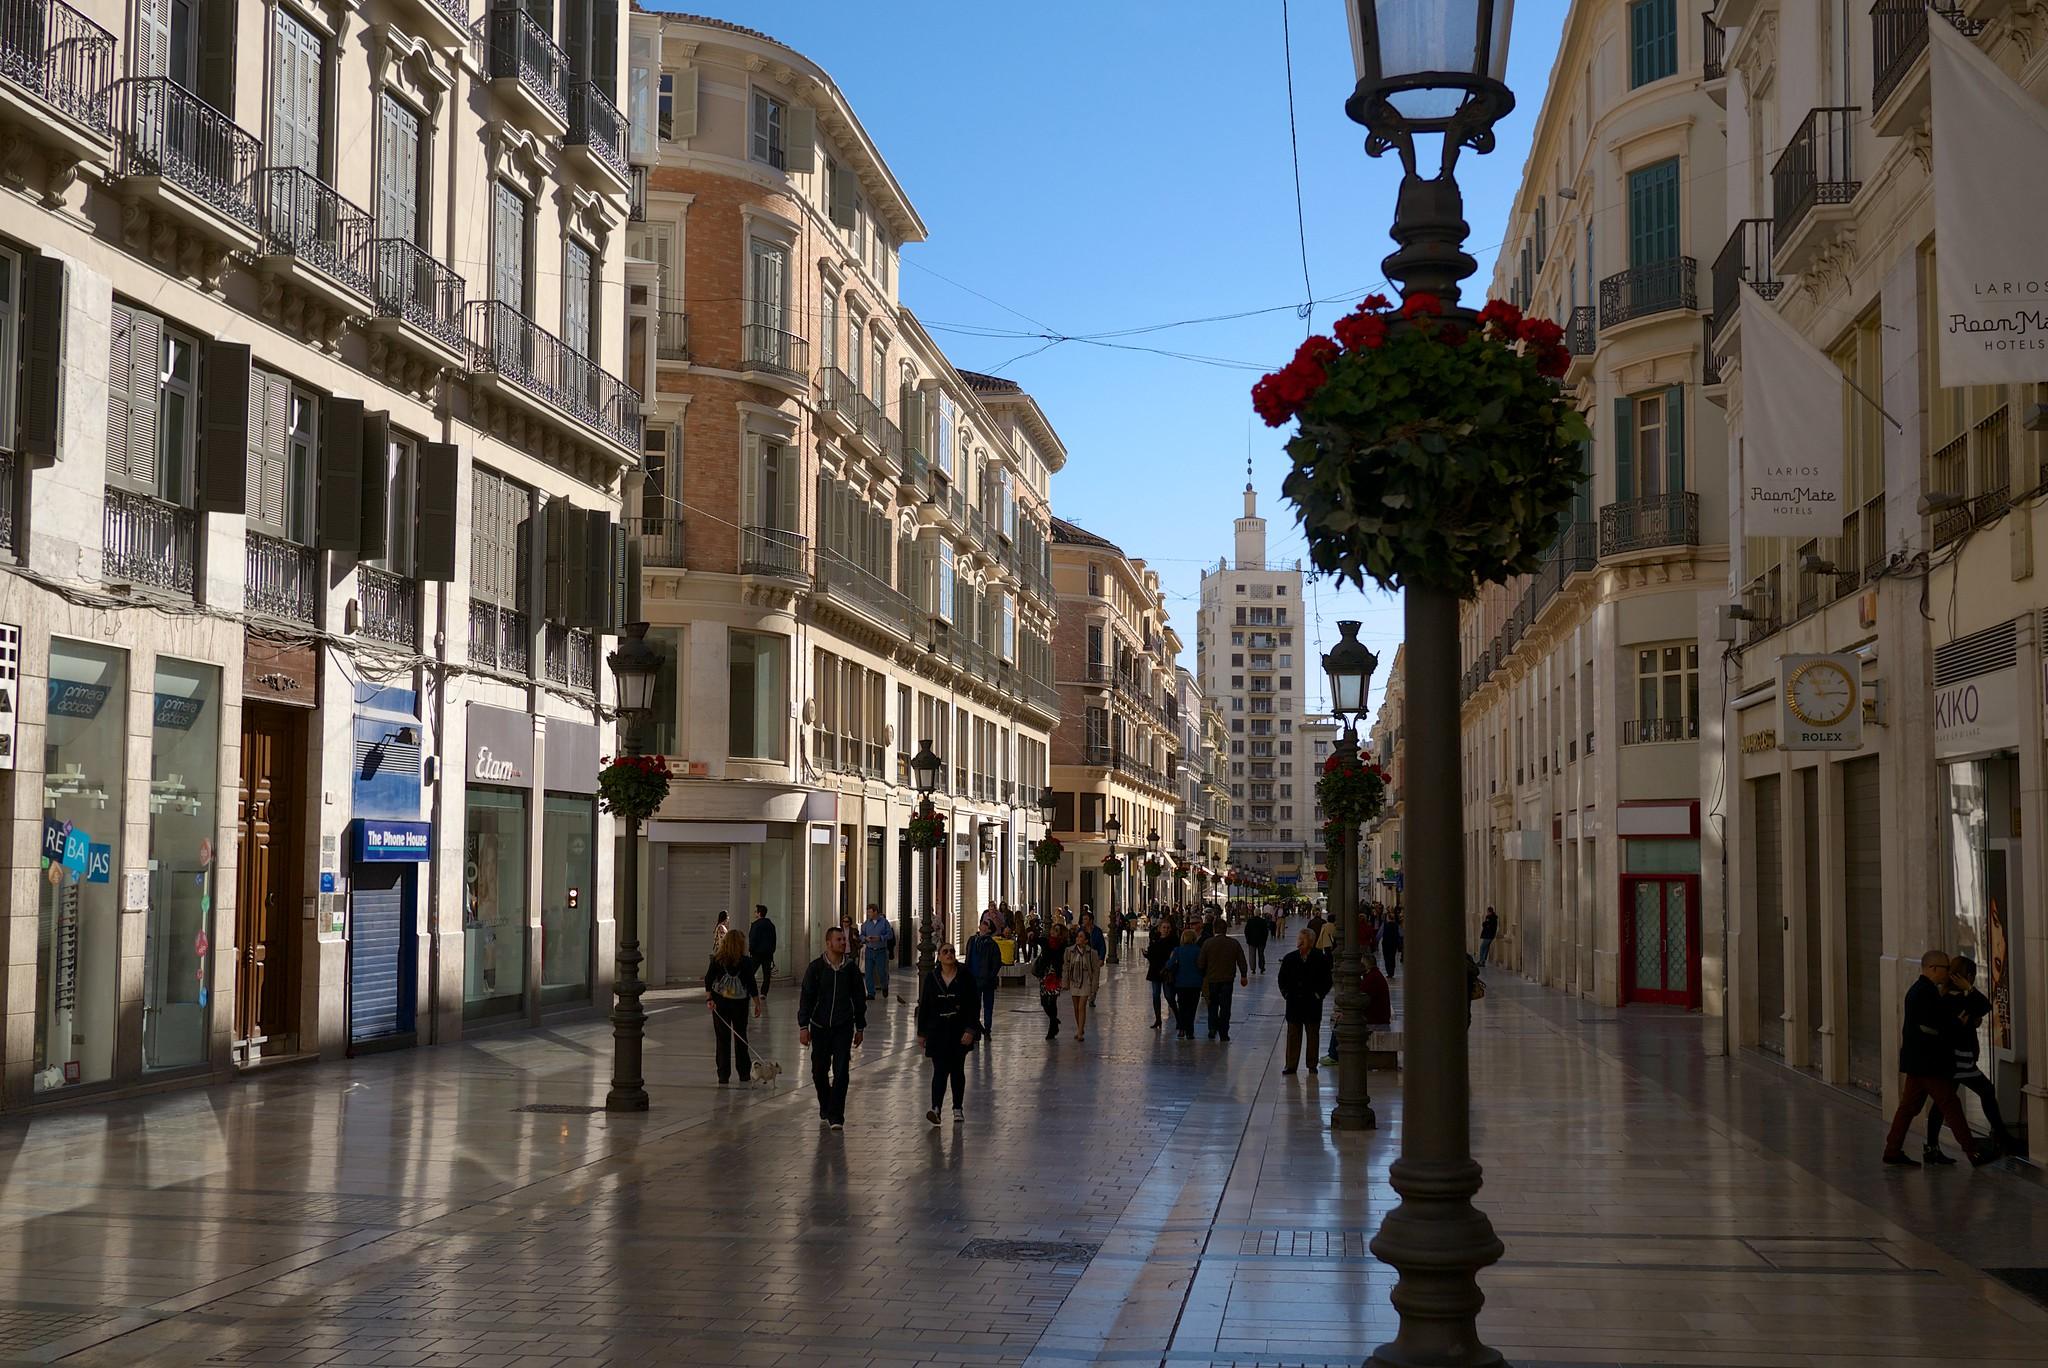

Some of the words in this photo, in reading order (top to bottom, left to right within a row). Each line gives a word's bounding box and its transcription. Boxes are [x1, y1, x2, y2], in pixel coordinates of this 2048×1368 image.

[1985, 339, 2046, 351] HOTELS
[1767, 467, 1819, 476] LARIOS
[1773, 507, 1813, 515] HOTELS
[63, 685, 105, 701] primera
[1935, 684, 1979, 730] KIKO
[1801, 733, 1842, 742] ROLEX
[475, 745, 513, 781] Etam
[368, 830, 382, 846] The
[383, 831, 405, 846] Phone
[406, 831, 427, 847] House
